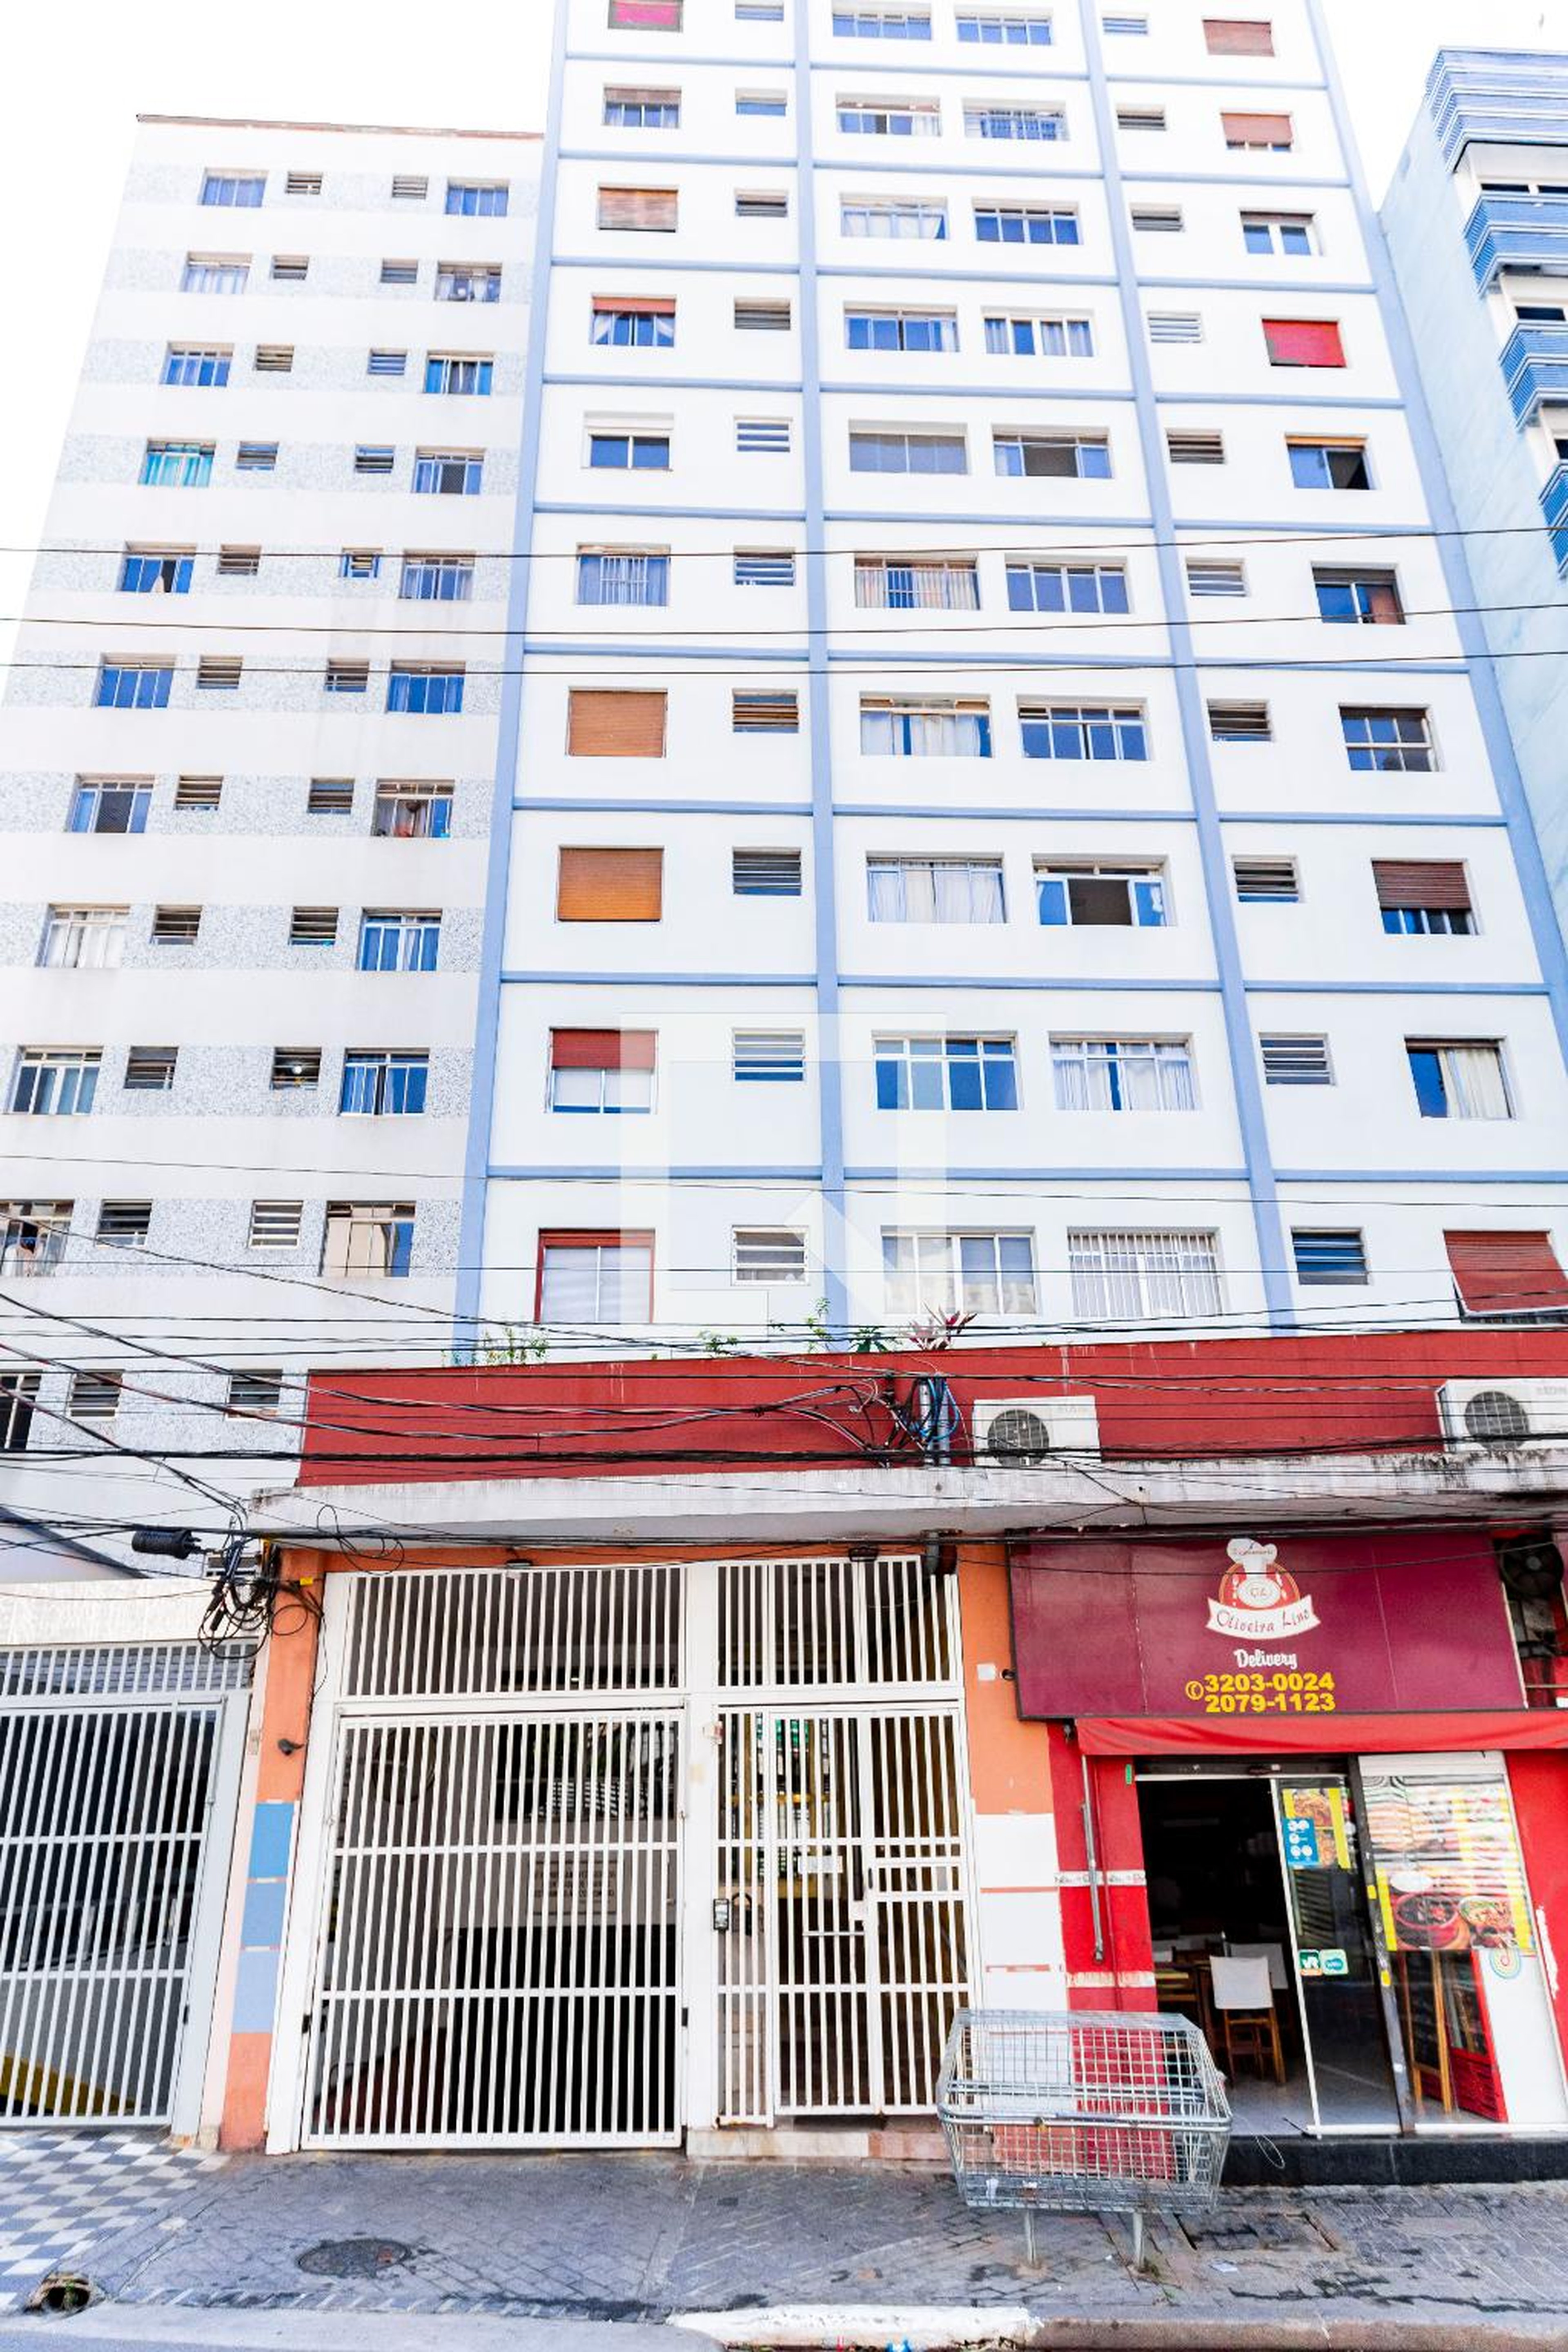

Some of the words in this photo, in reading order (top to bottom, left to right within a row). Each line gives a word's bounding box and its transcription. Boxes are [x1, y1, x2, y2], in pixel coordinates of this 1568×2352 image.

[1217, 1610, 1274, 1633] Oliveira
[1233, 1648, 1298, 1670] Delivery
[1204, 1672, 1335, 1693] 3203-0024
[1204, 1693, 1336, 1713] 2079-1123
